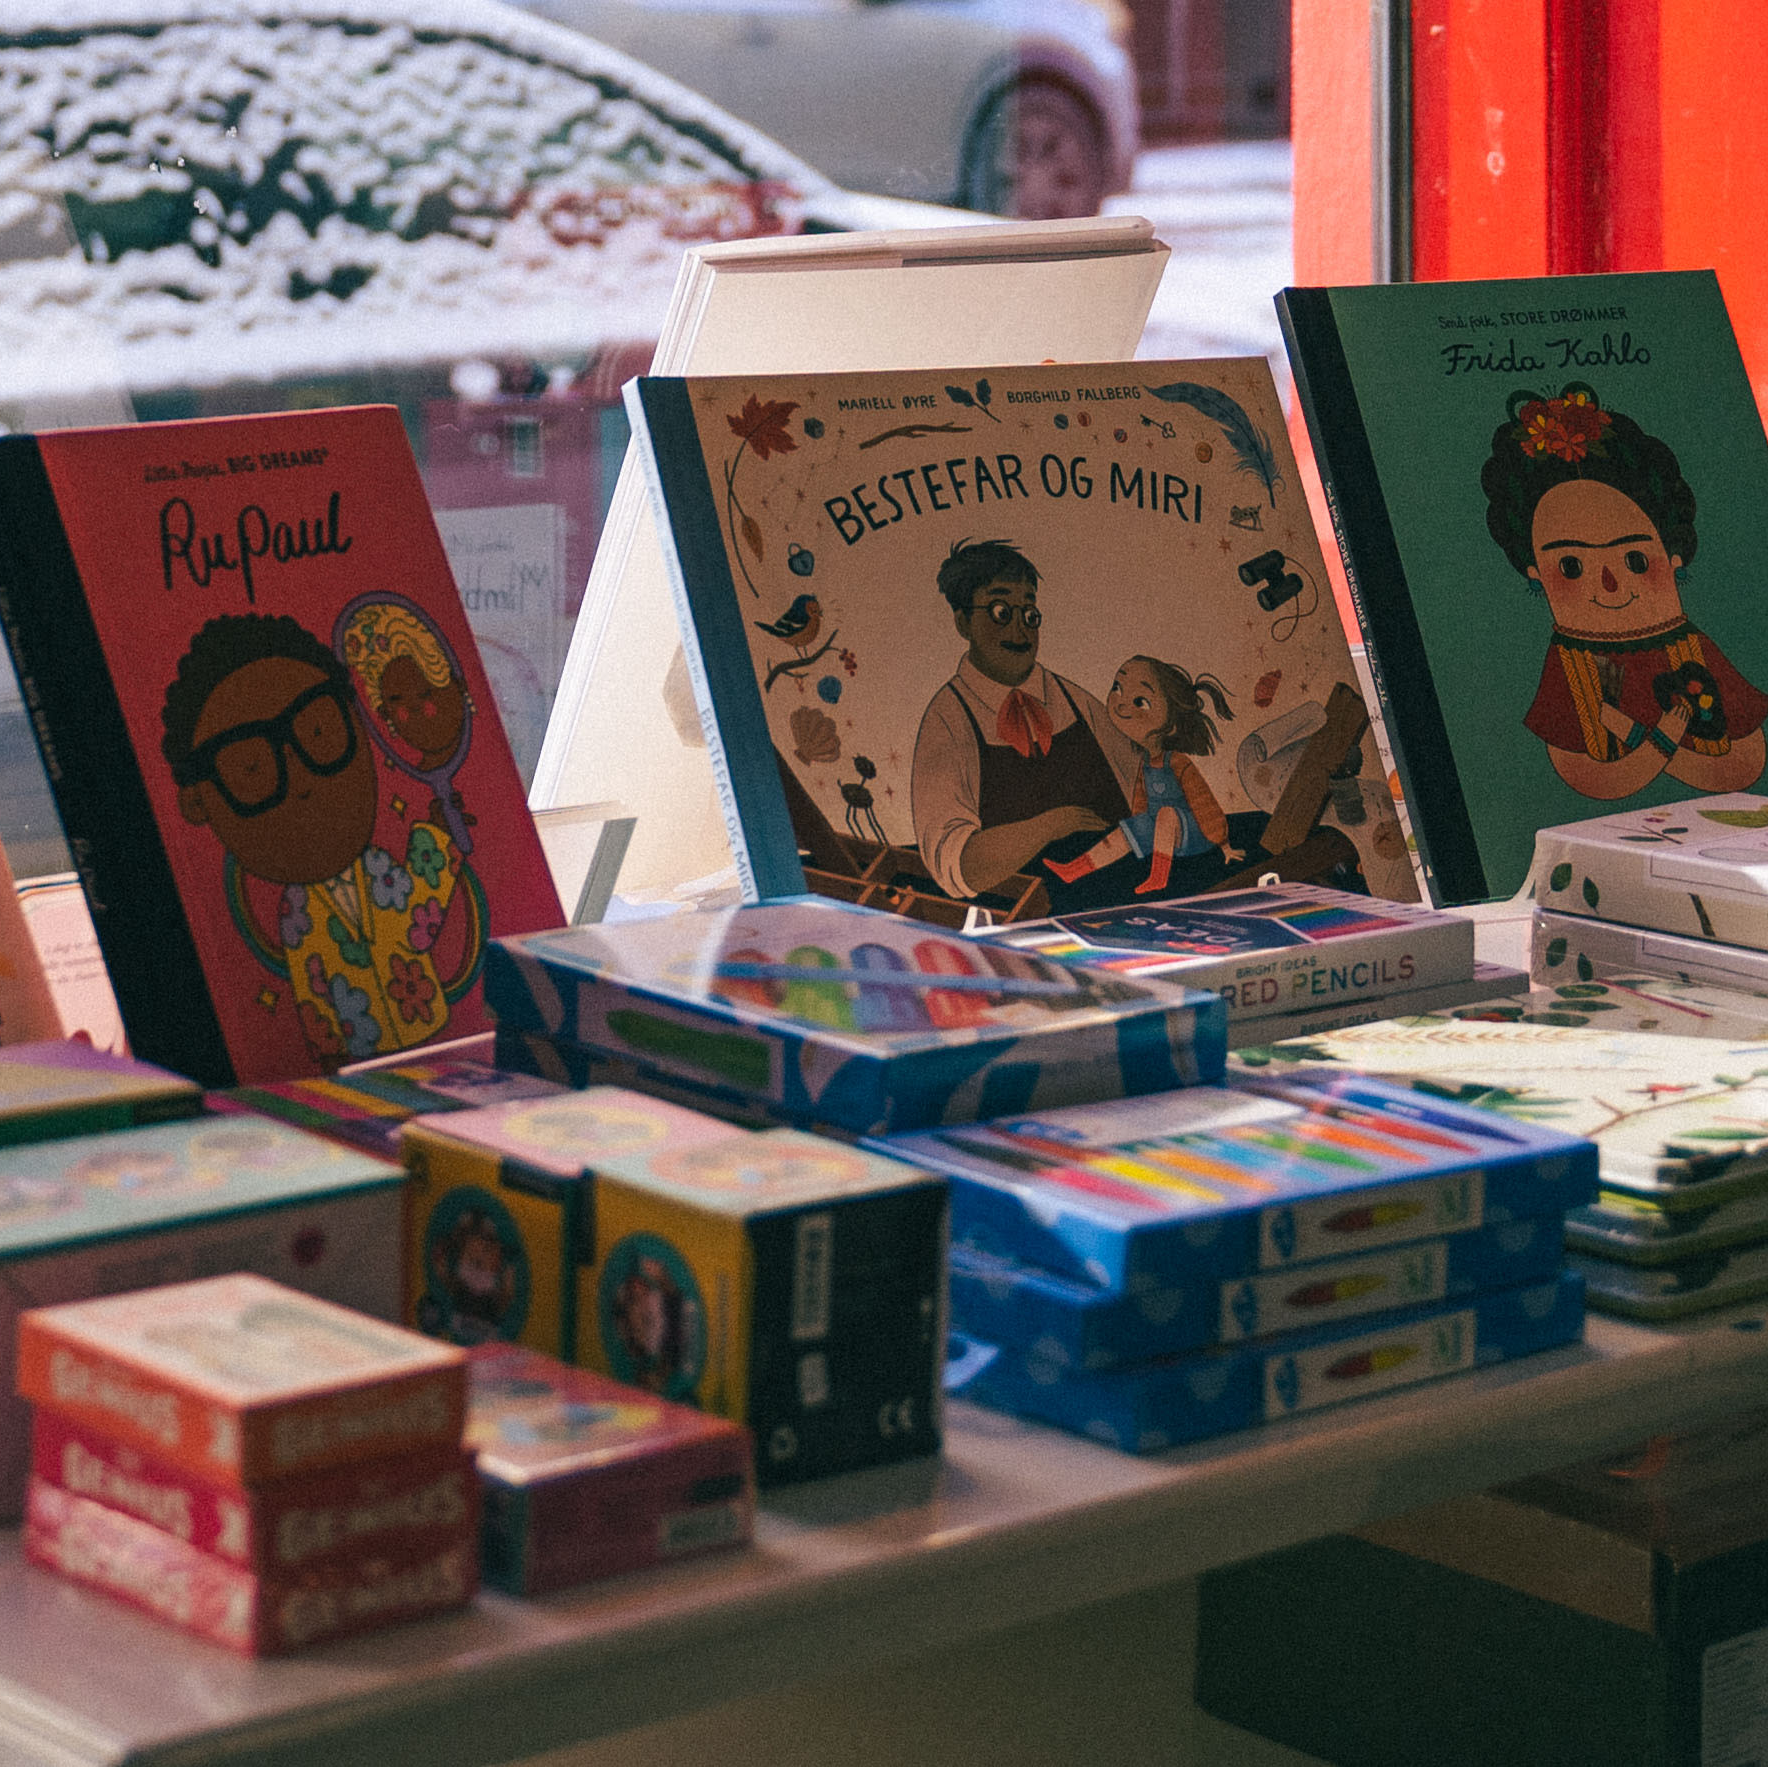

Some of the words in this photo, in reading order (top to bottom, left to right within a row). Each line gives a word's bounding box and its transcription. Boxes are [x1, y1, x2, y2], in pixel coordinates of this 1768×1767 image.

[1500, 309, 1548, 326] STORE
[1550, 307, 1629, 324] DRØMMER
[1440, 338, 1545, 377] Frida
[1545, 332, 1651, 369] Kahlo
[838, 396, 897, 412] MARIELL
[902, 394, 938, 410] ØYRE
[1006, 389, 1072, 404] BORGHILD
[1076, 386, 1142, 402] FALLBERG
[226, 455, 256, 474] BIG
[823, 453, 1030, 547] BESTEFAR
[1039, 452, 1094, 500] OG
[1109, 461, 1203, 524] MIRI
[159, 491, 353, 604] RuPaul
[1236, 962, 1277, 980] BRIGHT
[1281, 955, 1317, 972] IDEAS
[1291, 954, 1416, 999] PENCILS
